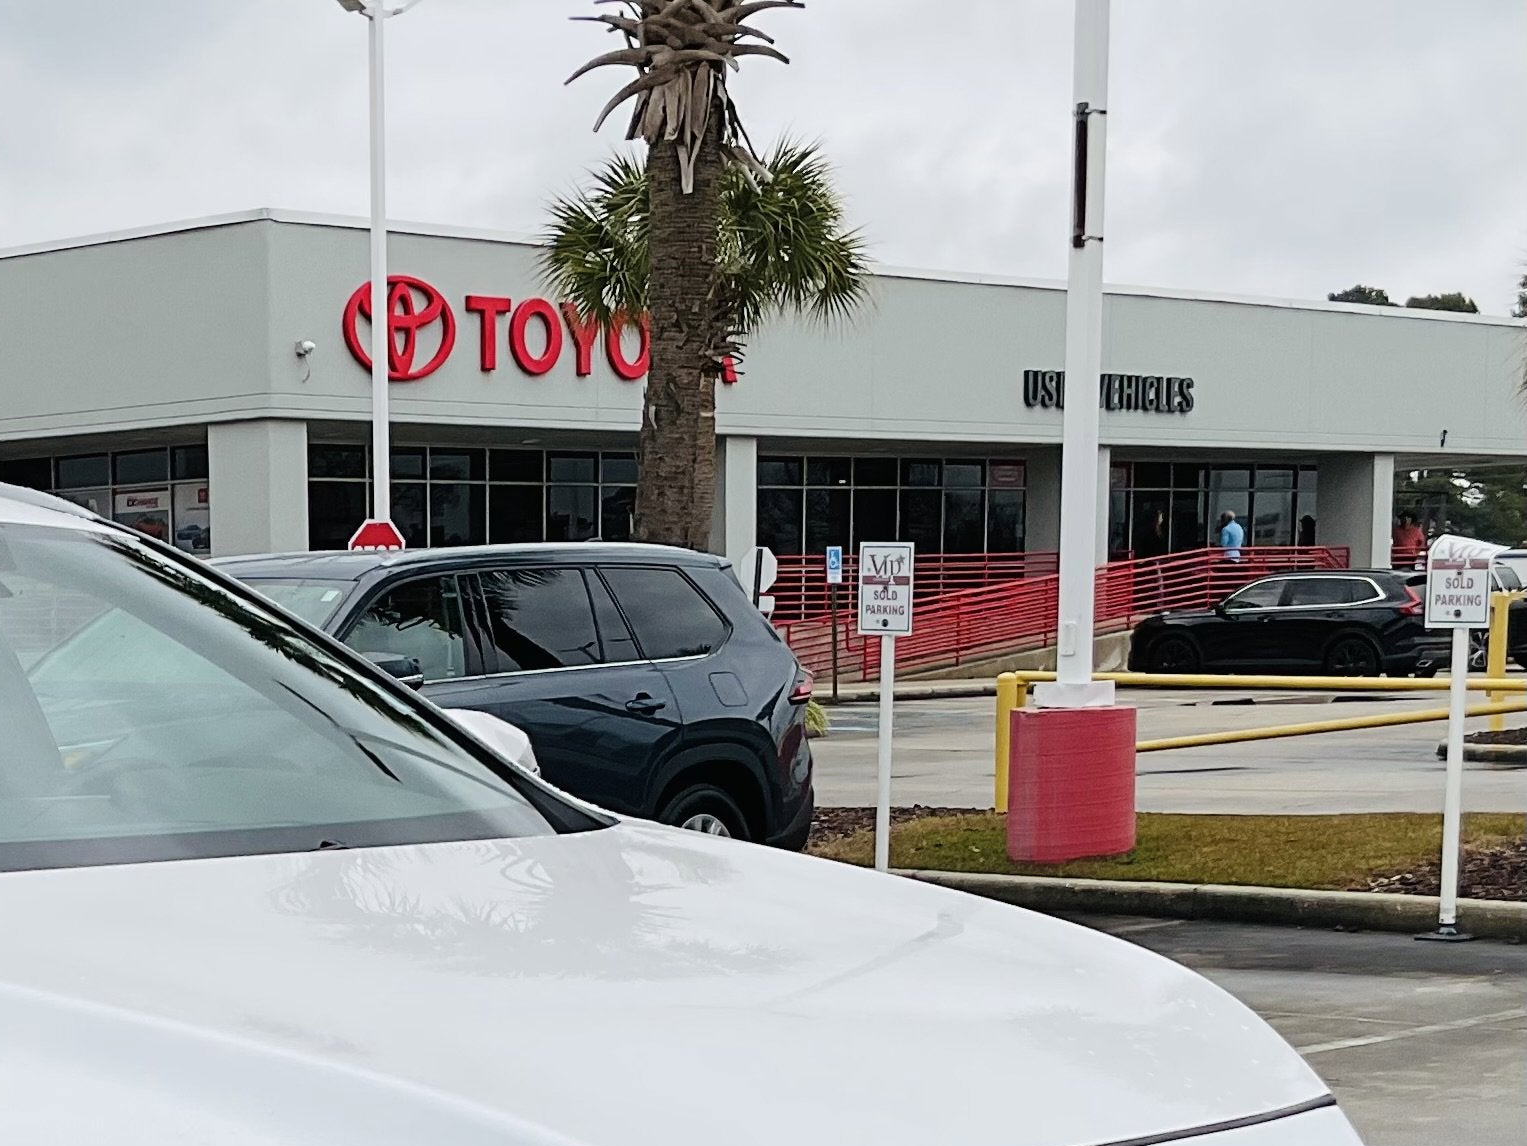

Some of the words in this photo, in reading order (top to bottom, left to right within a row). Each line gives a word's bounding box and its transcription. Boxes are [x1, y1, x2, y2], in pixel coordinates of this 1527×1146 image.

[465, 295, 738, 384] TOYO
[1023, 370, 1065, 409] US
[1445, 578, 1474, 589] SOLD
[873, 590, 898, 600] SOLD
[1435, 594, 1482, 606] PARKING
[865, 604, 905, 615] PARKING
